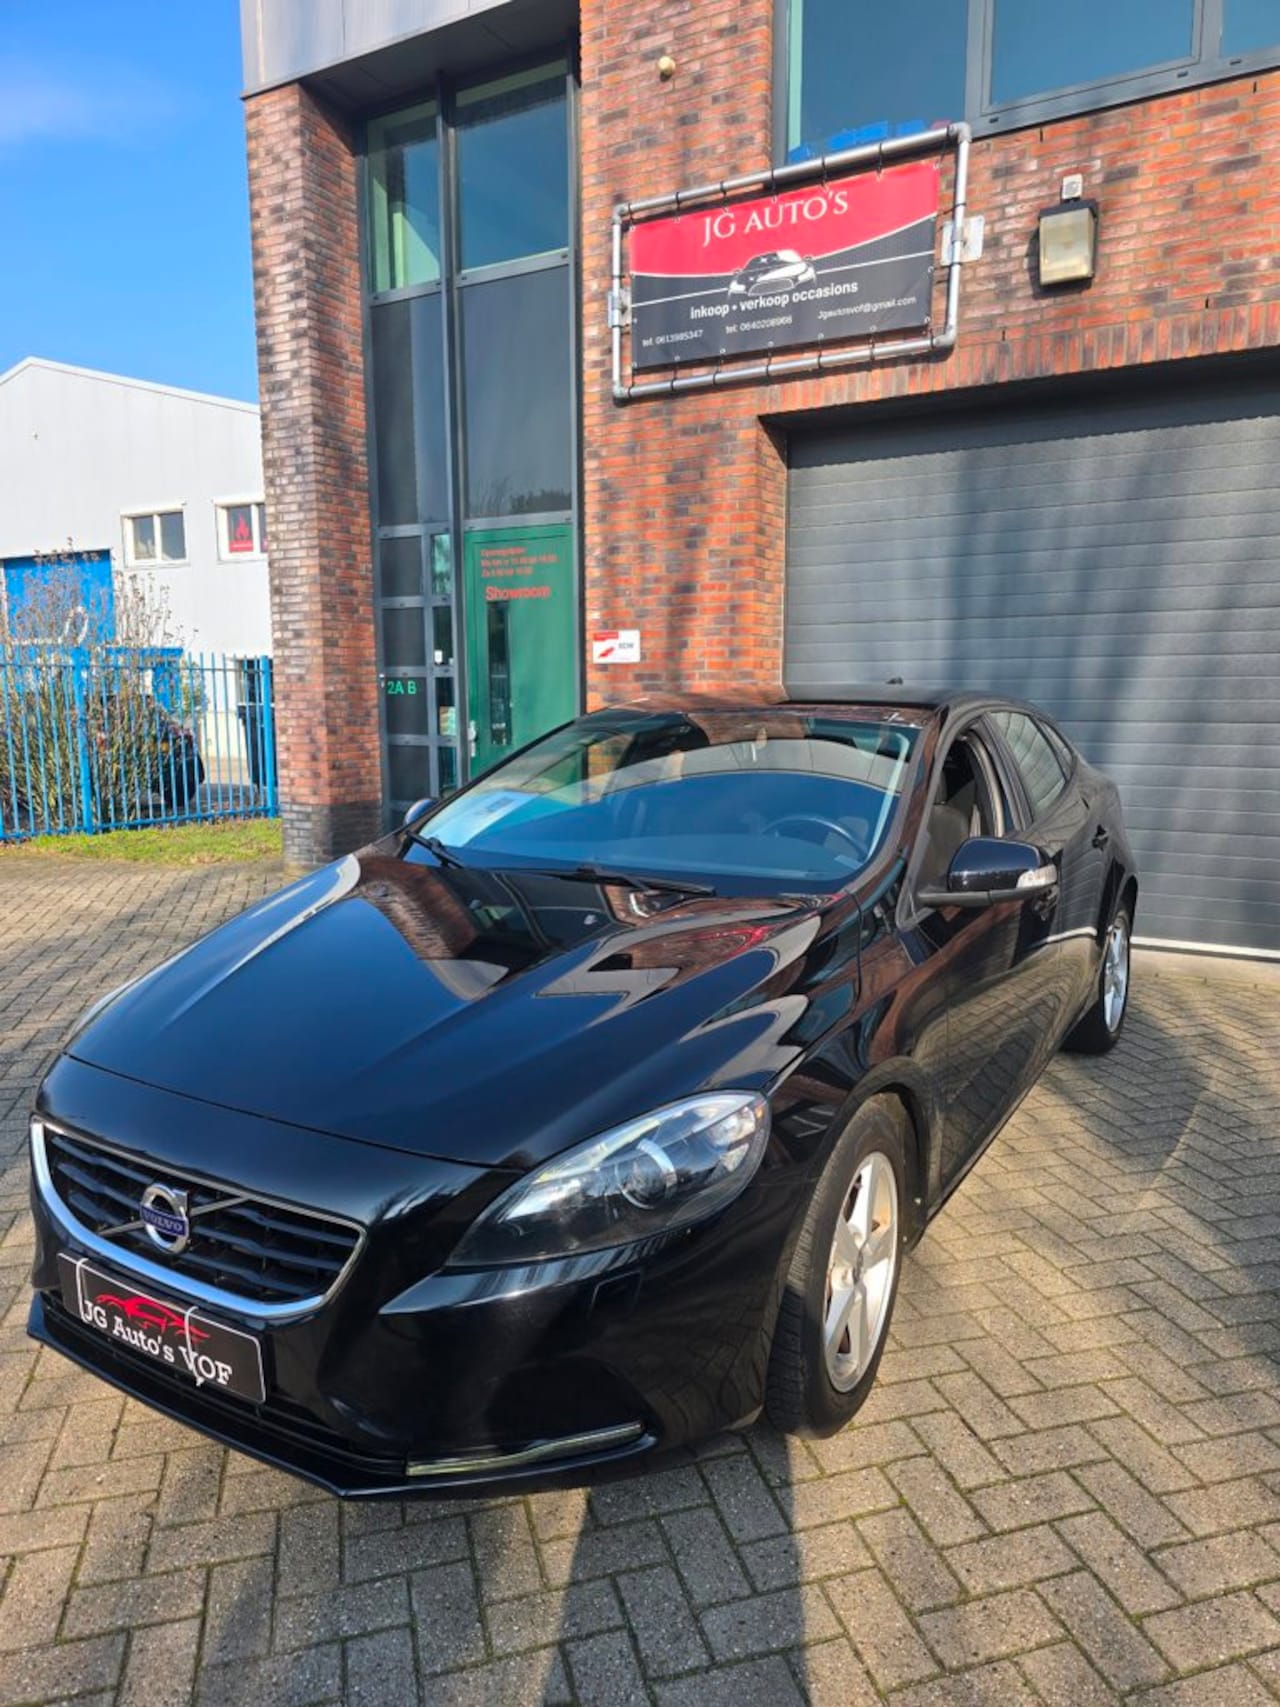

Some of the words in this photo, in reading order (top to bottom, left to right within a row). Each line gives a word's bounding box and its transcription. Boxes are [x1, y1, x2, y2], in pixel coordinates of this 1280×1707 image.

[703, 212, 735, 247] JG
[745, 191, 849, 234] AUTO'S
[690, 305, 730, 320] inkoop
[739, 293, 790, 311] verkoop
[792, 281, 859, 303] occasions
[486, 586, 550, 600] Showroom
[142, 1206, 184, 1231] VOLVO
[83, 1299, 107, 1329] JG
[112, 1315, 175, 1363] Auto's
[178, 1345, 233, 1385] VOF
